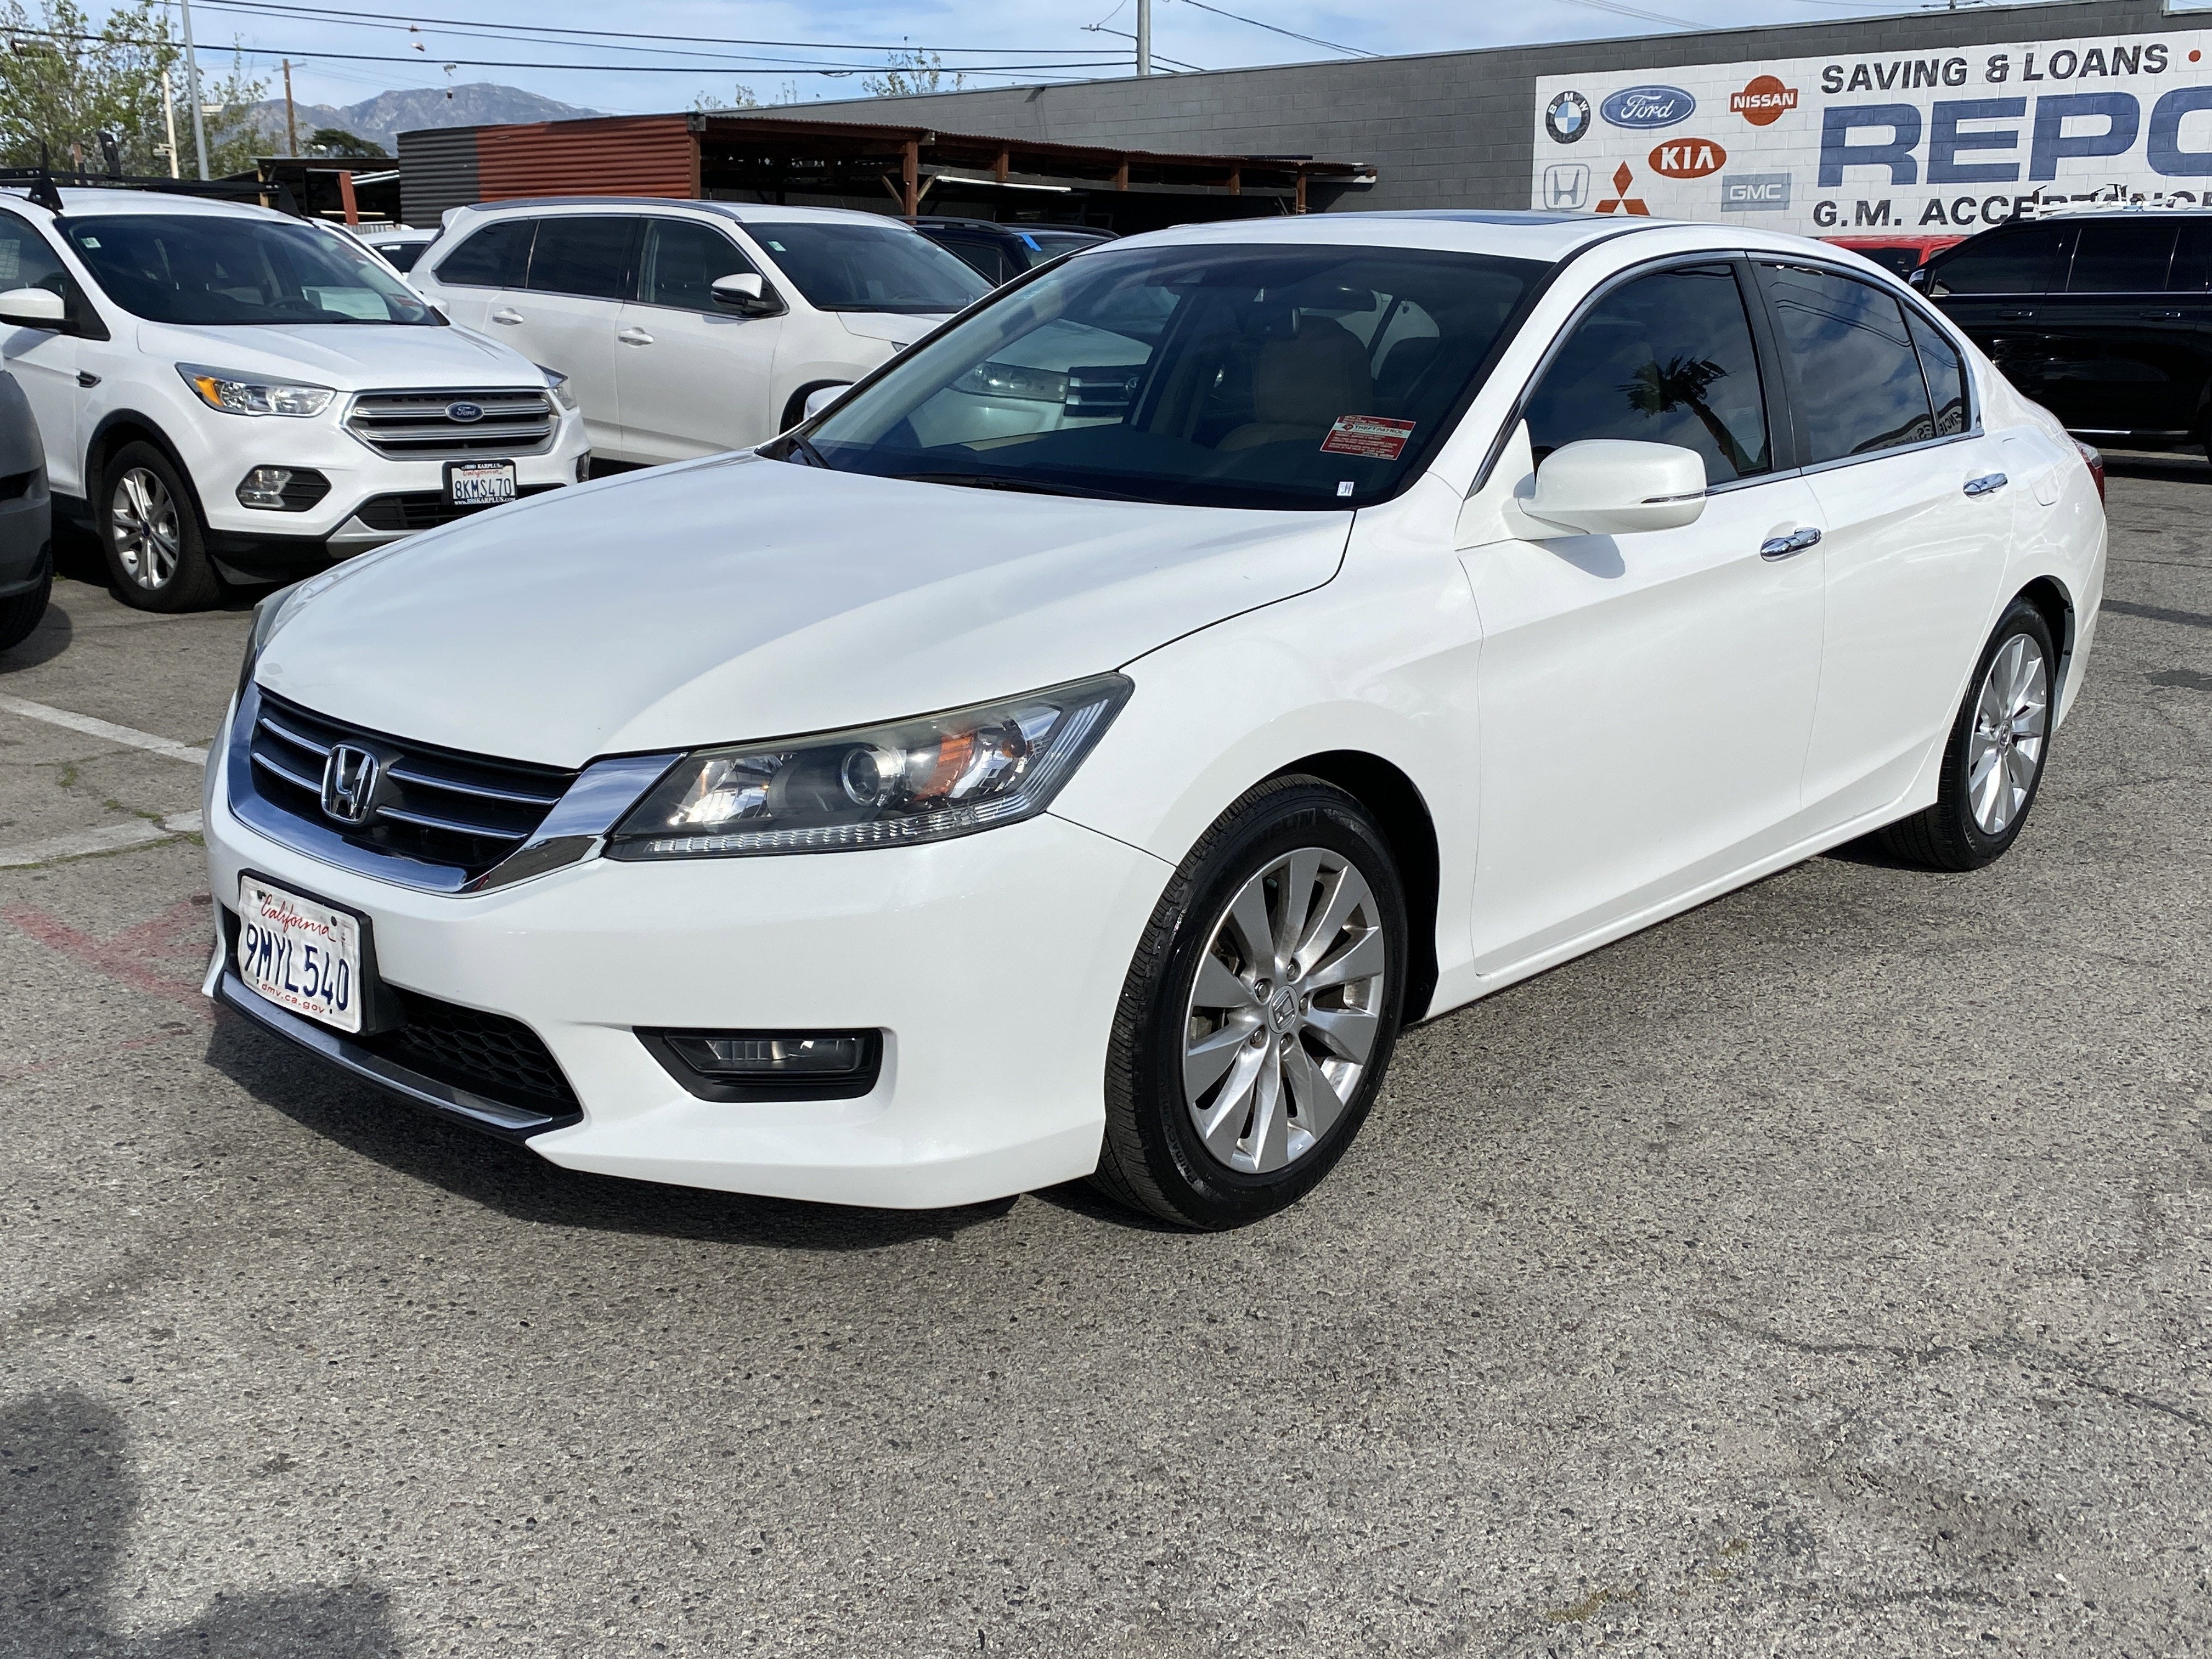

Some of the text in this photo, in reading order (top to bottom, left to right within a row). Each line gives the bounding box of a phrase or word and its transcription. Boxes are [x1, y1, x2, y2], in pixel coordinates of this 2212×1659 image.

[1821, 43, 2169, 94] SAVING & LOANS
[1548, 92, 1590, 115] BMW
[1620, 94, 1673, 119] Ford
[1733, 92, 1795, 109] NISSAN
[1660, 145, 1716, 171] KIA
[1729, 183, 1783, 201] GMC
[1813, 199, 1903, 227] G.M.
[456, 406, 476, 416] Ford
[454, 478, 512, 499] 8KMS470
[260, 894, 336, 943] California
[245, 923, 349, 1011] 9MYL540
[261, 983, 325, 1014] dmv.ca.gov
